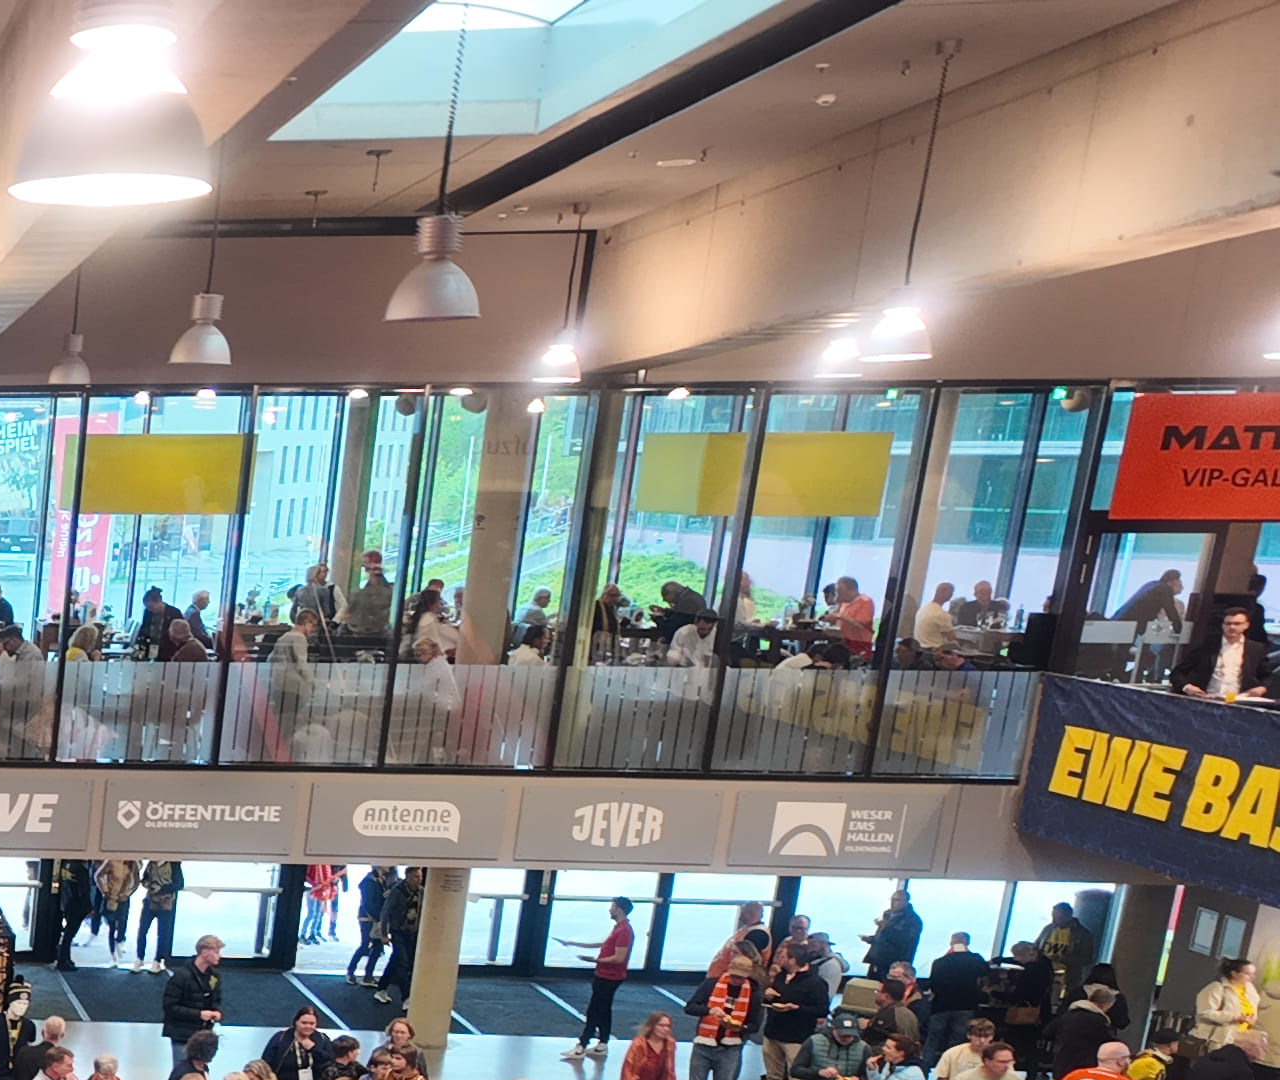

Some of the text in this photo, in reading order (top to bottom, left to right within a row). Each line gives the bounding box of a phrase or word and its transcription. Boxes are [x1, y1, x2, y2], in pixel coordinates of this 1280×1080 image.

[1048, 724, 1280, 854] EWE BA
[146, 801, 282, 822] ÖFFENTLICHE
[850, 809, 893, 820] WESER
[572, 802, 664, 847] JEVER
[848, 821, 876, 831] EMS
[846, 832, 894, 842] HALLEN
